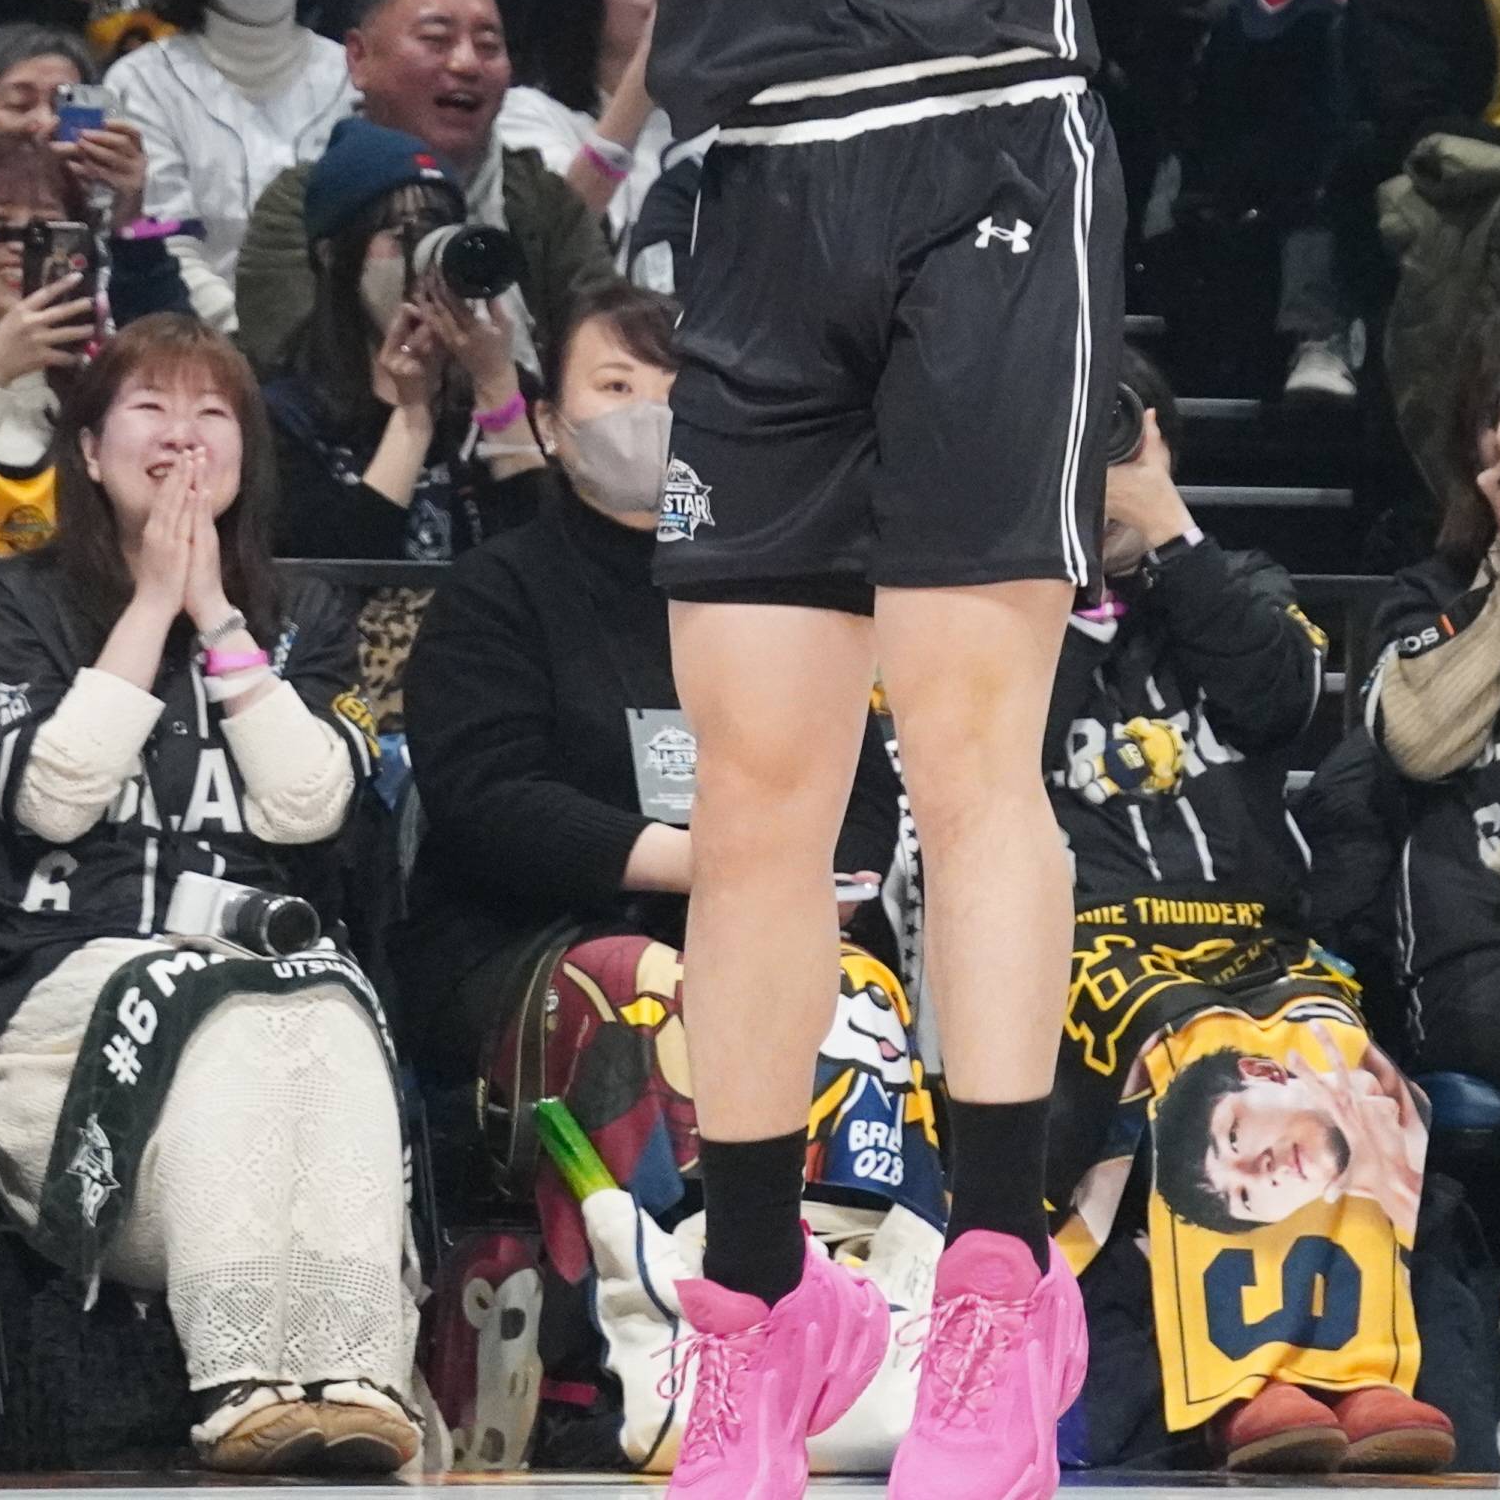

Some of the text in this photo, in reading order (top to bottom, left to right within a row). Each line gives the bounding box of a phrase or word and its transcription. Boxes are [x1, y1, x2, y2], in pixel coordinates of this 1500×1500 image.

[1132, 896, 1266, 929] THUNDERS
[102, 987, 159, 1086] #6
[852, 1148, 905, 1187] 028
